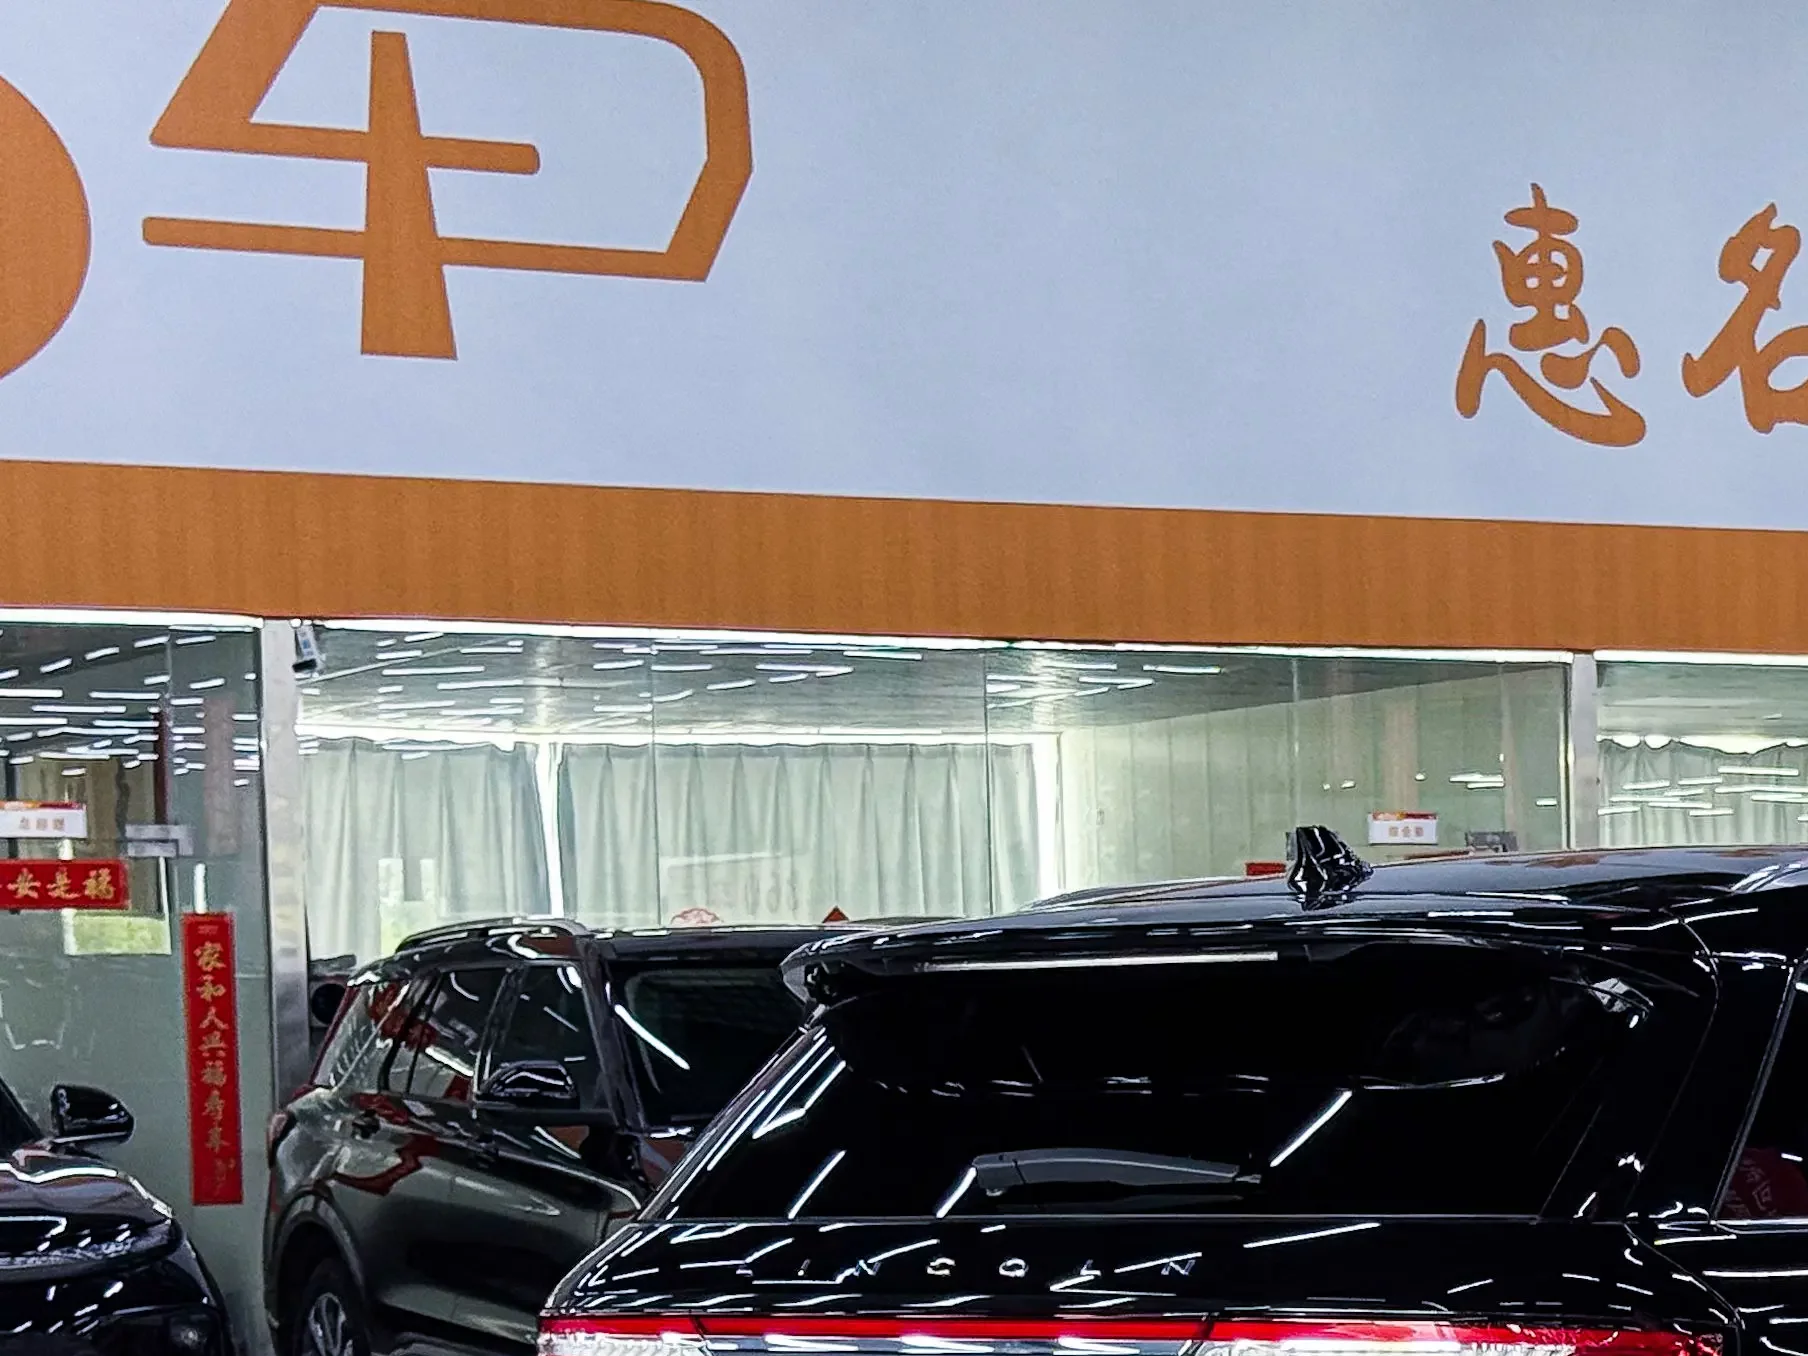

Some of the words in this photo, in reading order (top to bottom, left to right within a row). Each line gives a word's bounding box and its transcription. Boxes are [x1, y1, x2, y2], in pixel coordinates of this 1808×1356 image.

[0, 0, 754, 380] 车
[0, 866, 116, 899] 安是福
